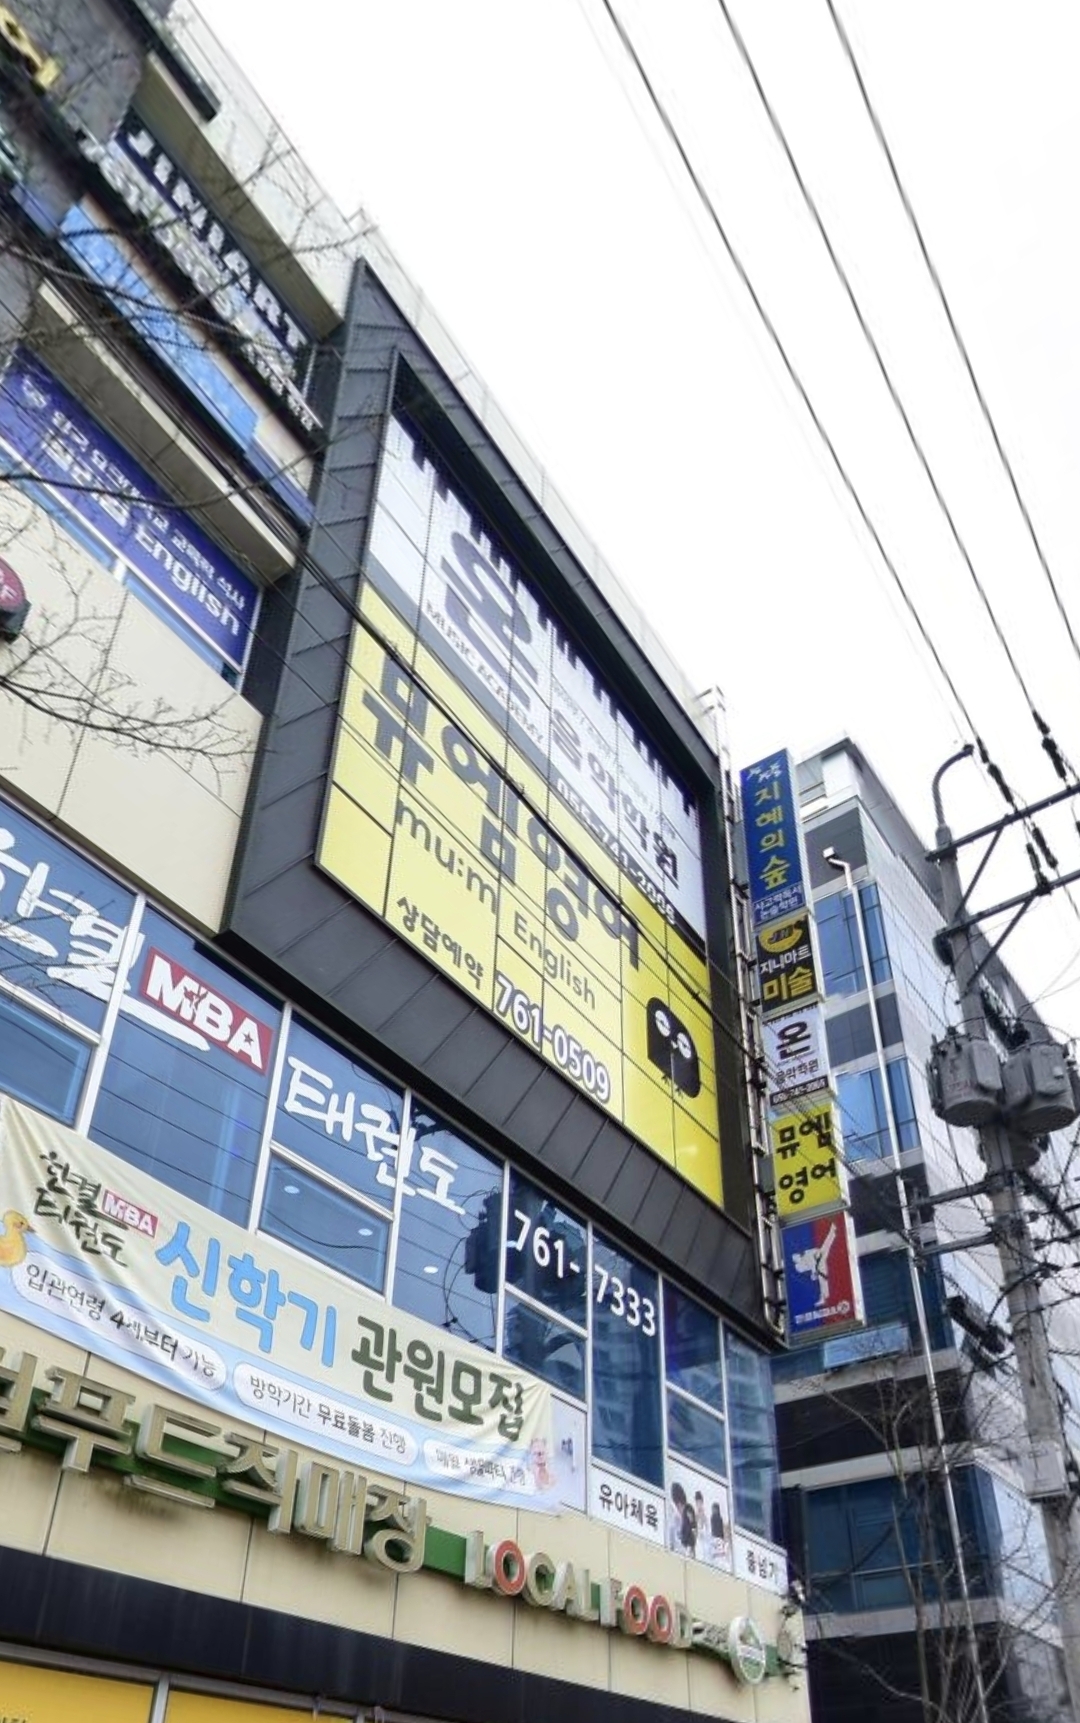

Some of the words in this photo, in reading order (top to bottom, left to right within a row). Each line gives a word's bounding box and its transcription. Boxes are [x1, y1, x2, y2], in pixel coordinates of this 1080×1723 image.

[135, 523, 239, 636] English
[440, 531, 538, 713] 온
[361, 652, 639, 971] 뮤엠영어
[553, 707, 680, 891] 음악학원
[397, 803, 498, 914] mu:m
[513, 910, 597, 1011] English
[396, 895, 484, 991] 상담예약
[496, 968, 612, 1103] 761-0509
[763, 966, 813, 1000] 미술
[146, 954, 263, 1069] MBA
[284, 1056, 466, 1216] 태권도
[775, 1021, 811, 1060] 온
[775, 1057, 819, 1085] 음악학원
[776, 1111, 831, 1160] 뮤엠
[778, 1157, 837, 1205] 영어
[104, 1191, 156, 1237] MBA
[26, 1263, 106, 1322] 입관연령
[183, 1347, 218, 1378] 가능
[155, 1221, 337, 1368] 신학기
[351, 1315, 524, 1442] 관원모집
[249, 1374, 312, 1419] 방학기간
[317, 1402, 376, 1444] 무료돌봄
[380, 1429, 406, 1455] 진행
[599, 1483, 659, 1530] 유아체육
[465, 1529, 599, 1622] LOCAL
[600, 1577, 693, 1650] FOOD
